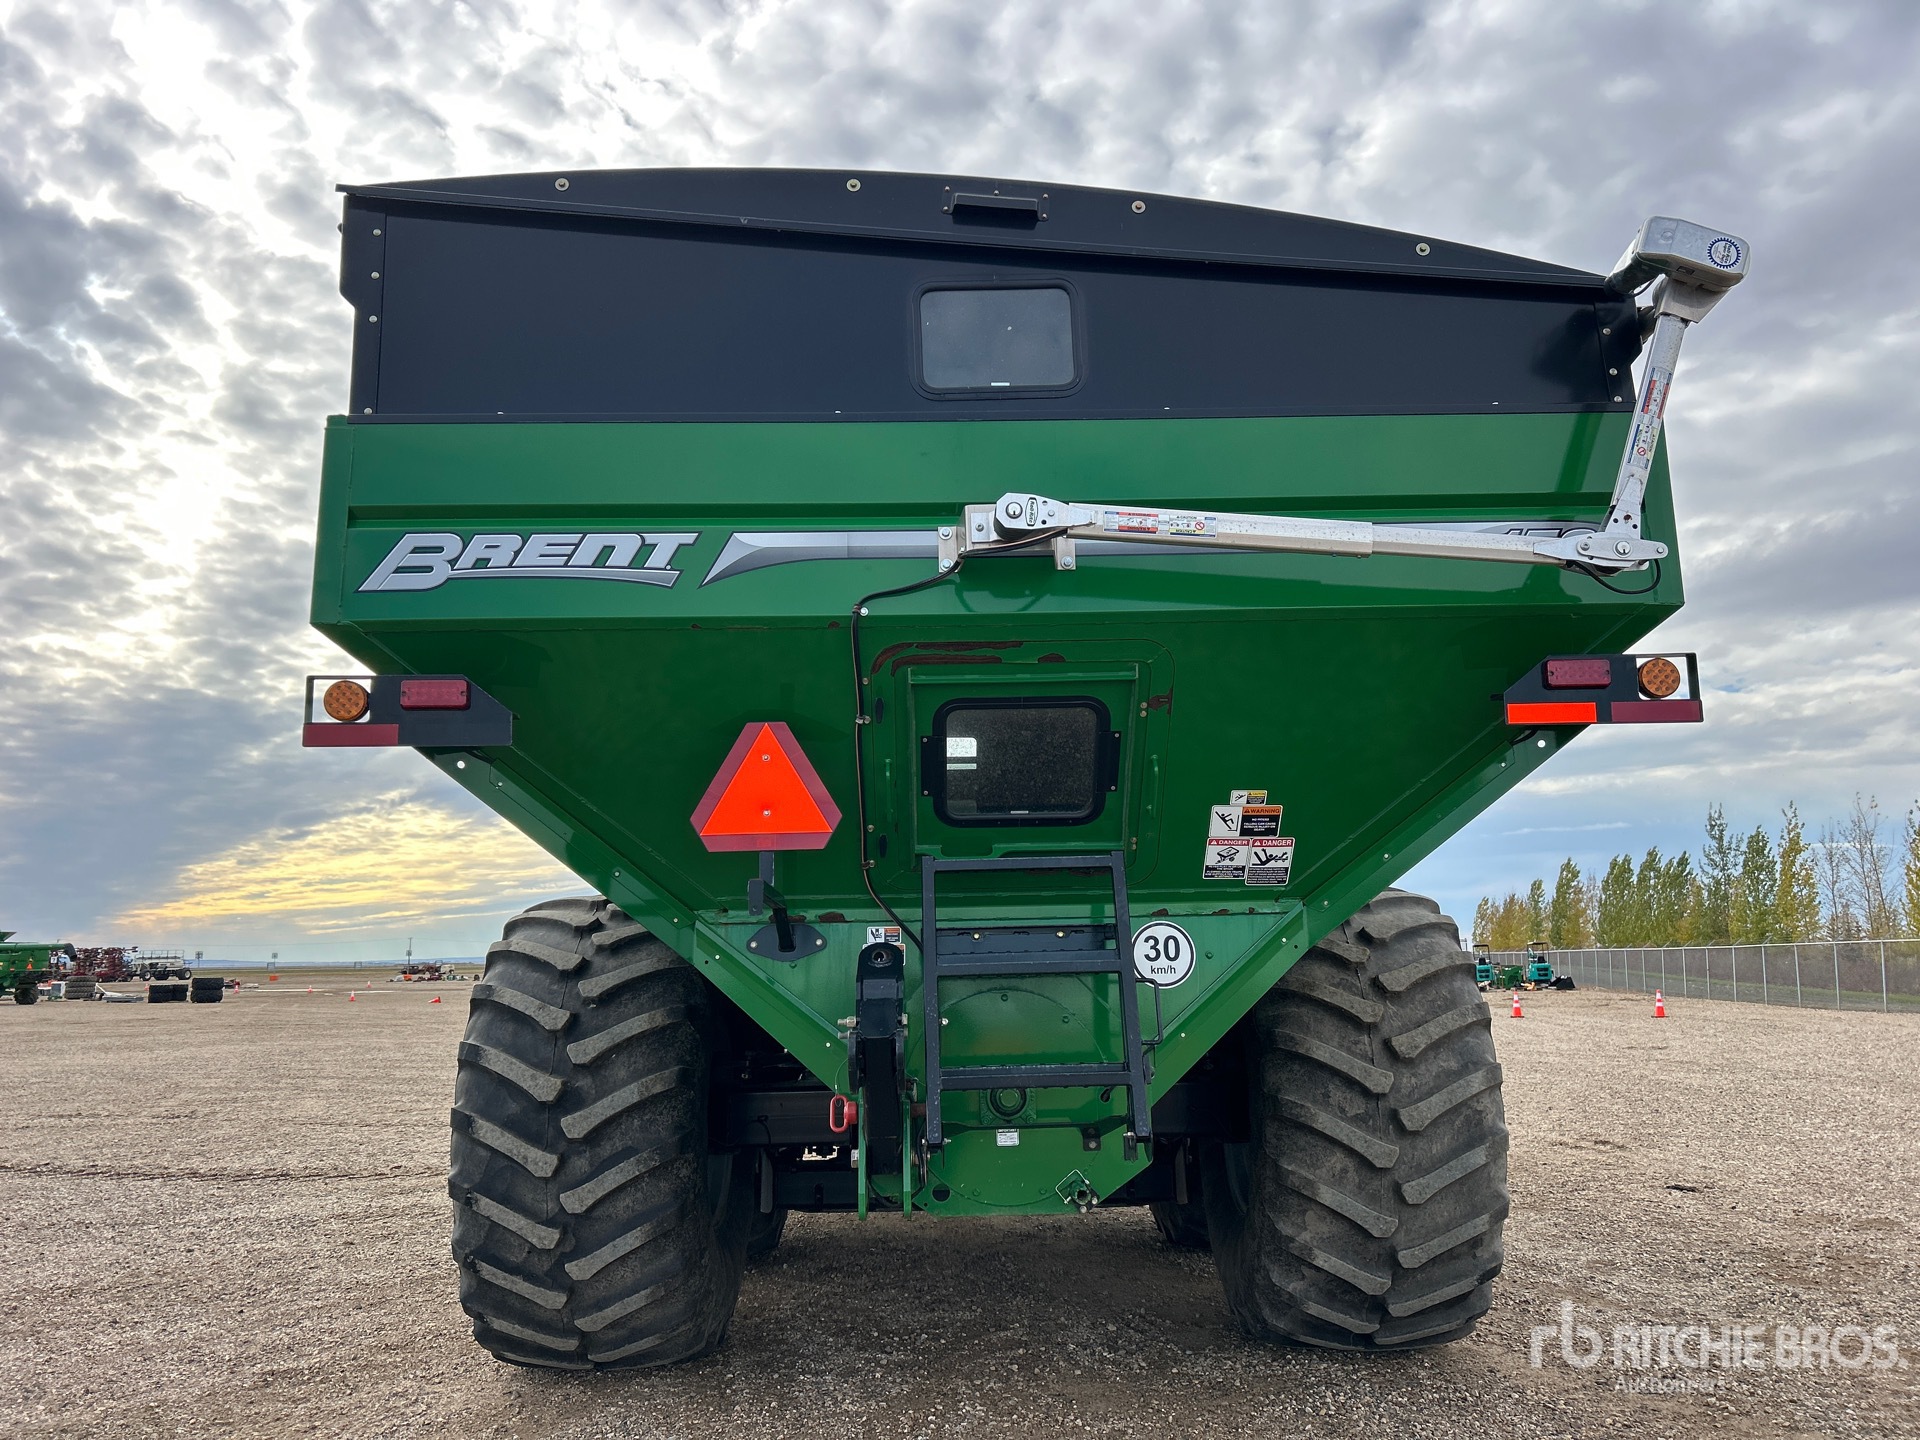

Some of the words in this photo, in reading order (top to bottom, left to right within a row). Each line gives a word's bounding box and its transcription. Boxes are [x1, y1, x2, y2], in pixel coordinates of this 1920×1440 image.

[357, 531, 702, 592] BRENT
[1262, 839, 1292, 847] DANGER
[1143, 935, 1181, 962] 30
[1150, 964, 1177, 975] km/h
